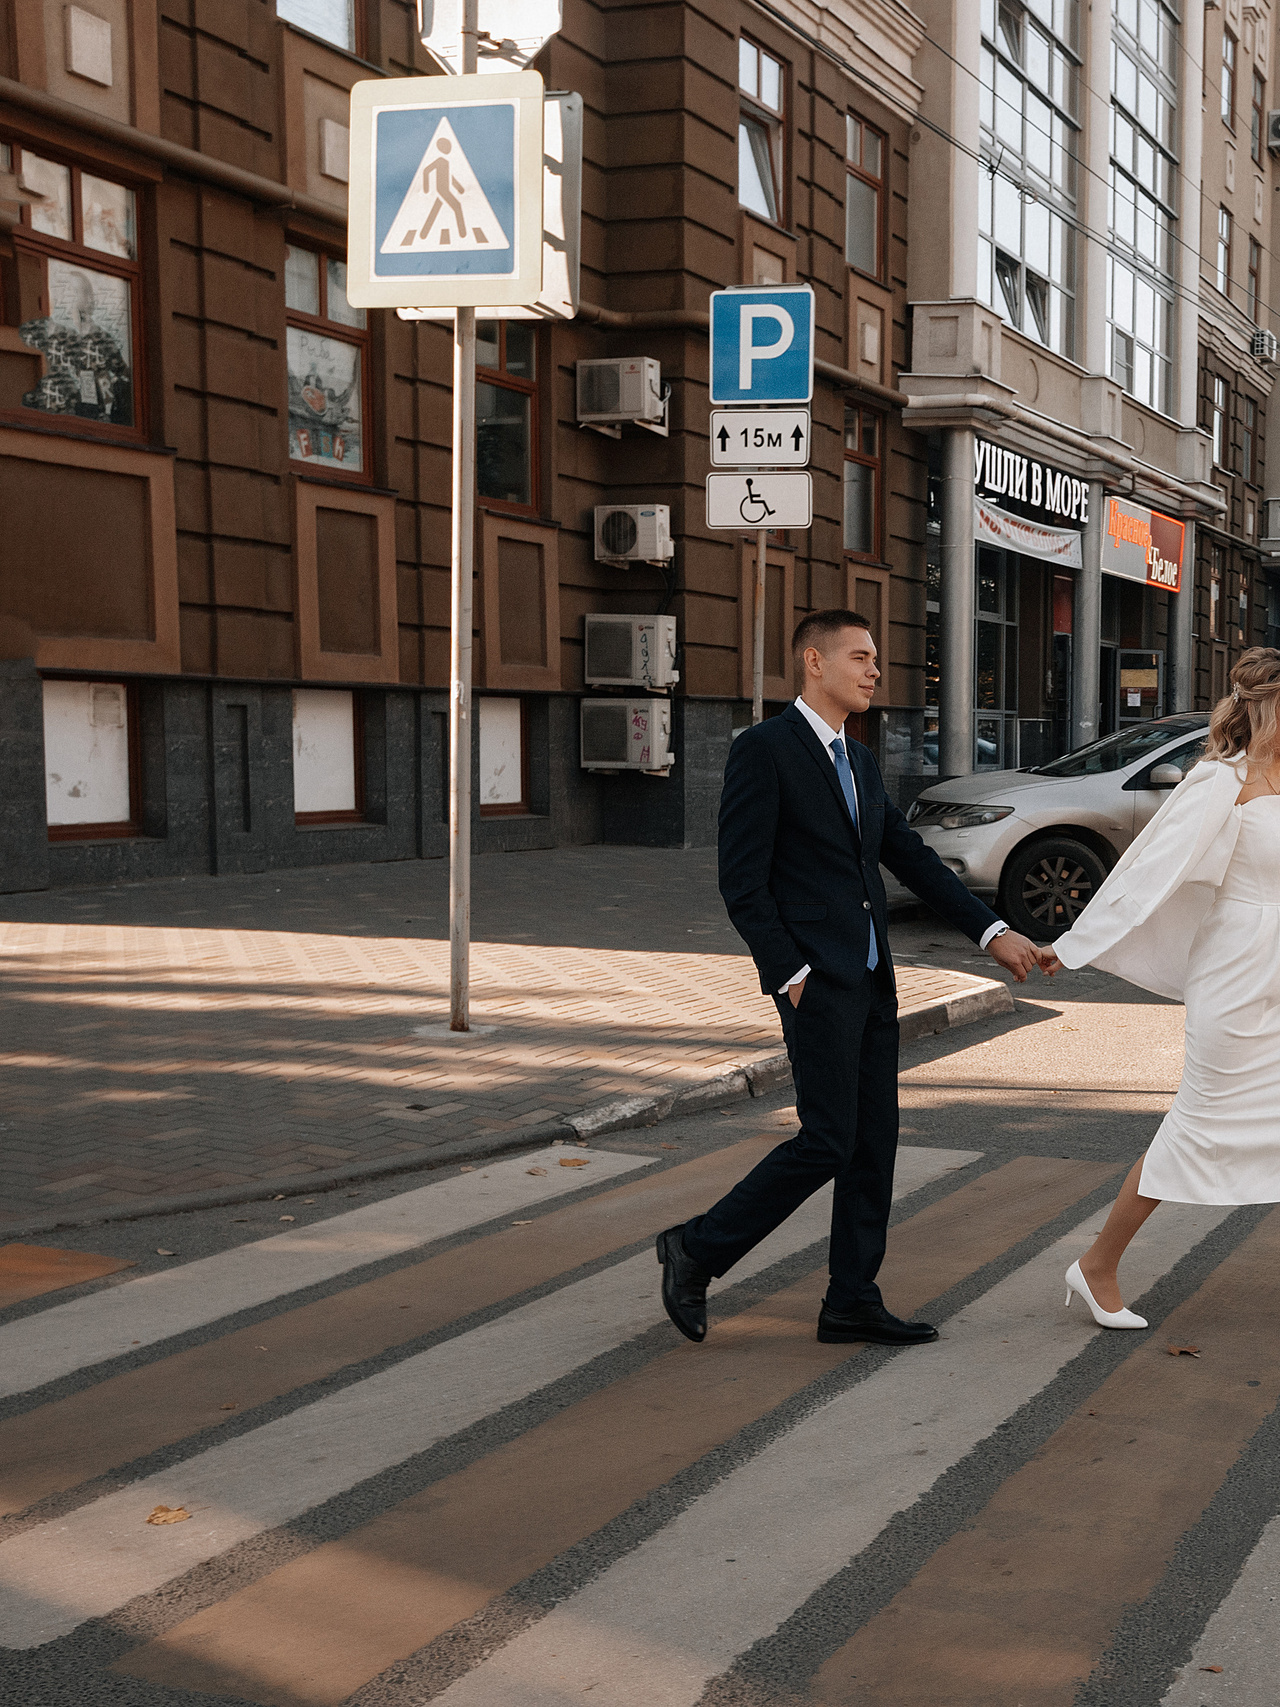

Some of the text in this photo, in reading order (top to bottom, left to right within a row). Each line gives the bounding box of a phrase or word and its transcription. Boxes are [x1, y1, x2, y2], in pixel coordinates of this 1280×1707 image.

[739, 303, 795, 390] P
[739, 427, 783, 448] 15м
[974, 437, 1090, 524] УШЛИ В МОРЕ
[1107, 499, 1150, 549] Красное
[1150, 546, 1178, 587] Белое
